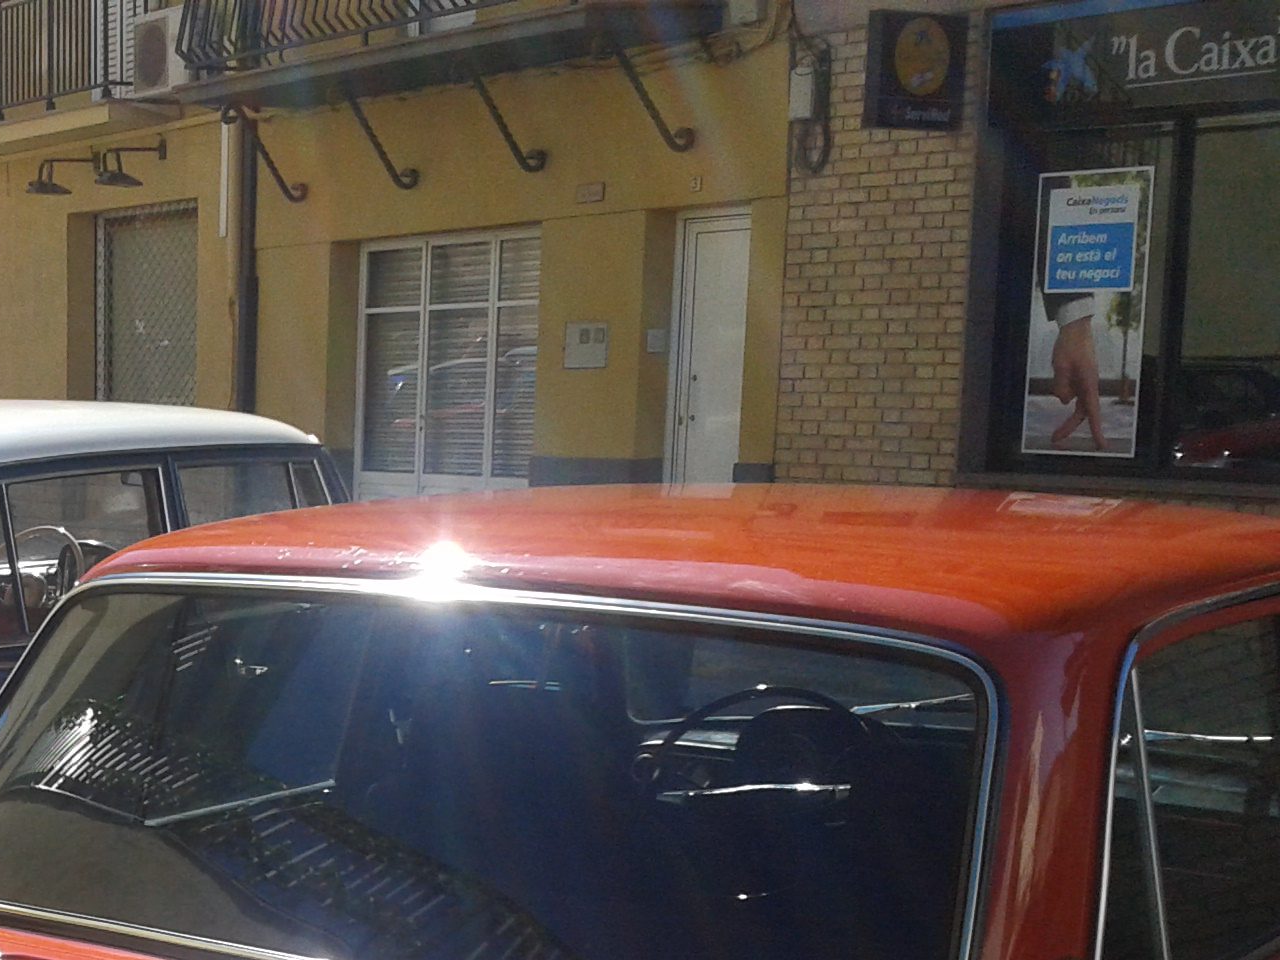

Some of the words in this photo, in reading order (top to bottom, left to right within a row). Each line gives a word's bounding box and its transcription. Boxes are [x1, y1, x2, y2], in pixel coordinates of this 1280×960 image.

[1165, 16, 1280, 75] Caixa
[1058, 231, 1108, 245] Arribem
[1056, 252, 1073, 263] on
[1104, 247, 1117, 261] el
[1056, 268, 1076, 280] teu
[1079, 265, 1120, 282] negoci
